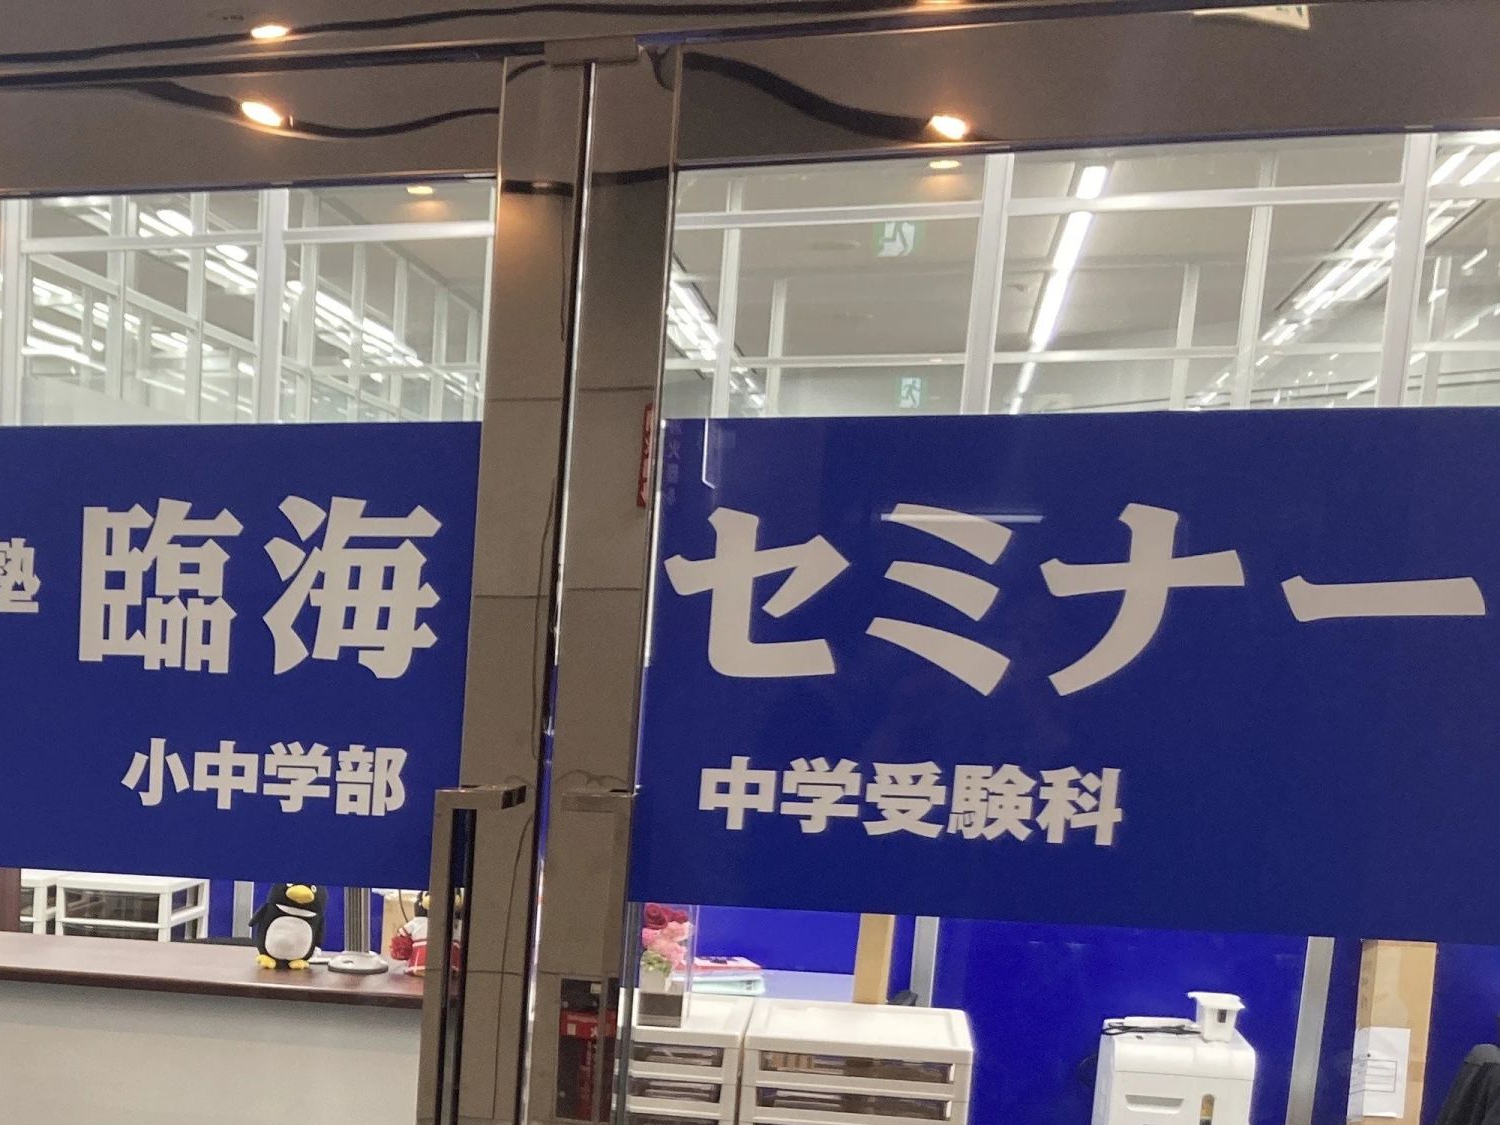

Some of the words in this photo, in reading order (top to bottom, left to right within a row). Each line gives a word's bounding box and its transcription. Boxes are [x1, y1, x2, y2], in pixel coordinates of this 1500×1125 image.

[78, 495, 443, 680] 臨海
[662, 501, 1487, 698] セミナー
[120, 737, 408, 818] 小中学部
[697, 754, 1124, 847] 中学受験科
